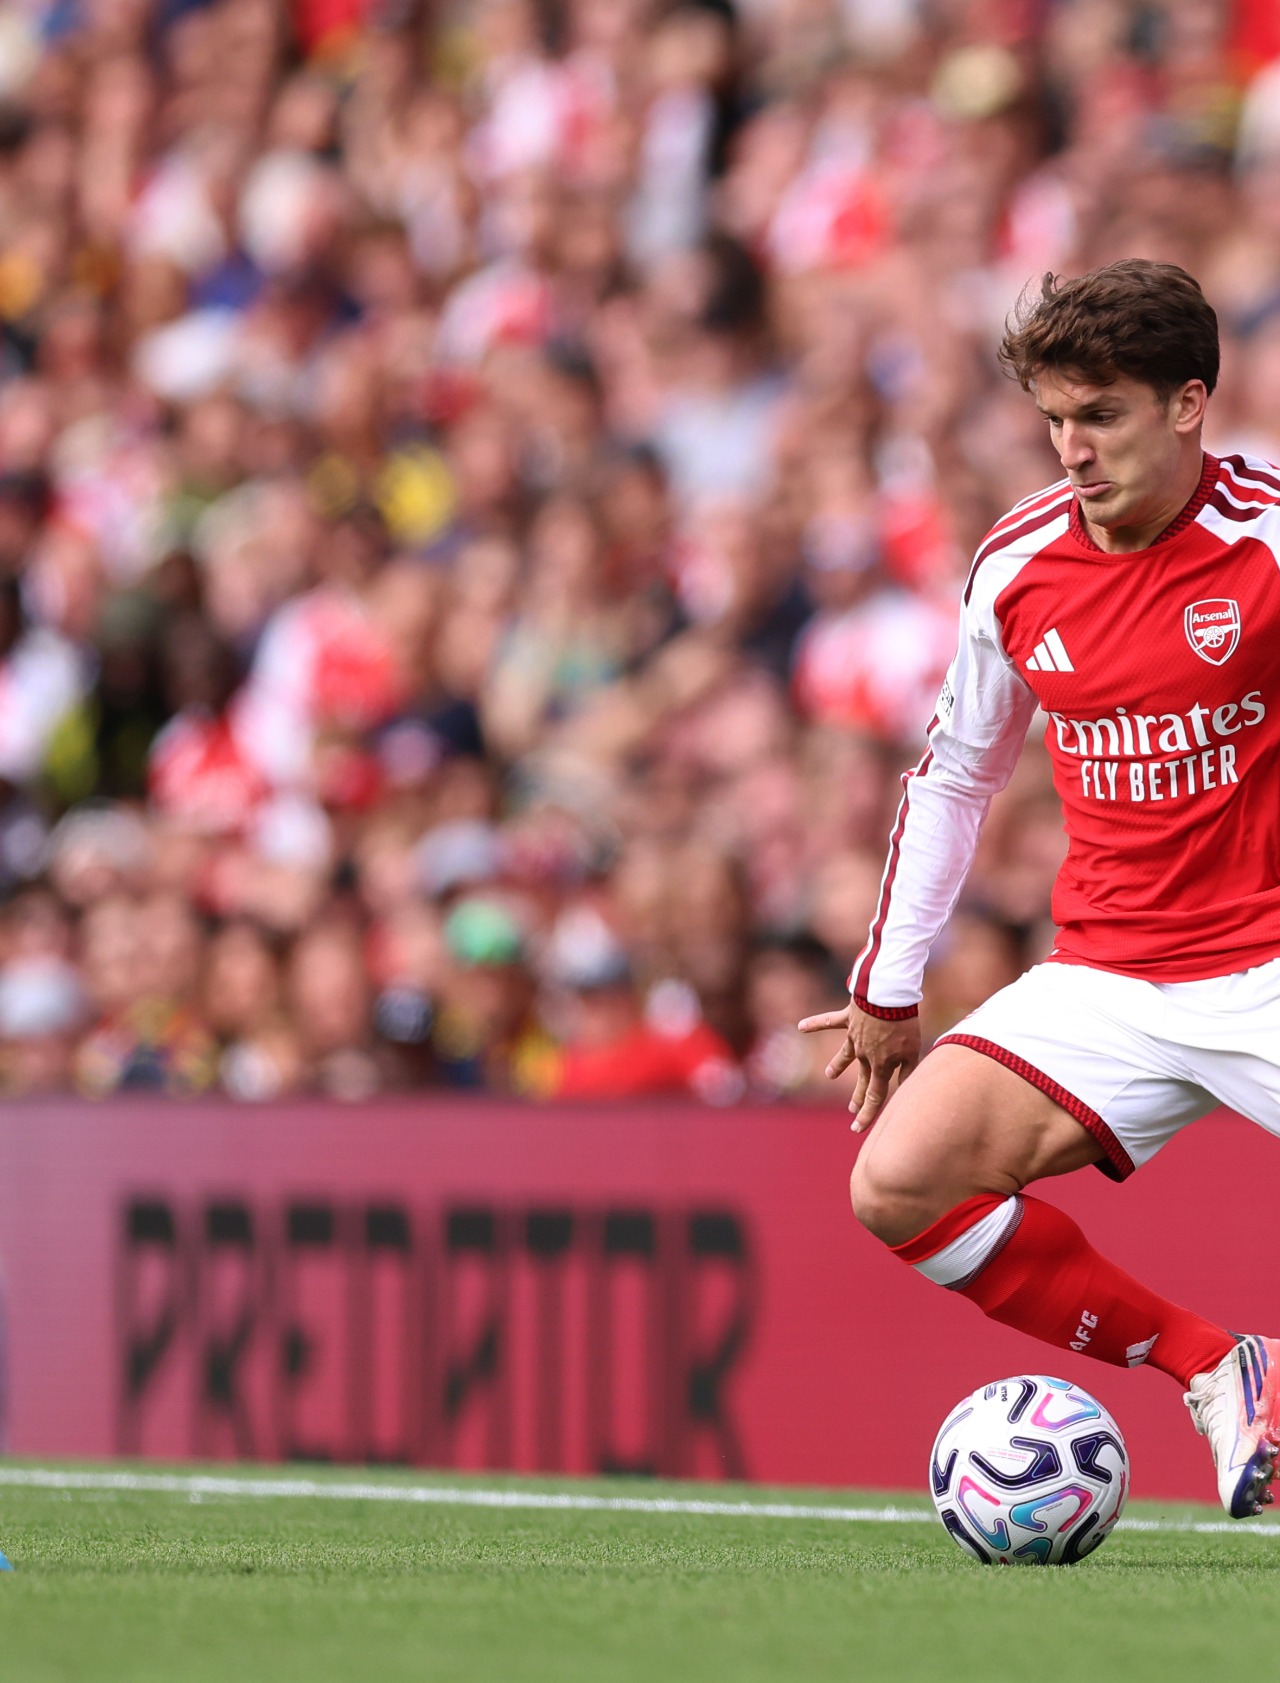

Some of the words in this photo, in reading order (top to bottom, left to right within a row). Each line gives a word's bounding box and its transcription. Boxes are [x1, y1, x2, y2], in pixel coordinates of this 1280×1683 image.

[1192, 608, 1232, 624] Arsenal
[1050, 690, 1266, 756] Emirates
[1081, 760, 1119, 801] FLY
[1129, 744, 1240, 802] BETTER
[116, 1198, 758, 1480] PREDATOR
[1069, 1309, 1099, 1351] AFC
